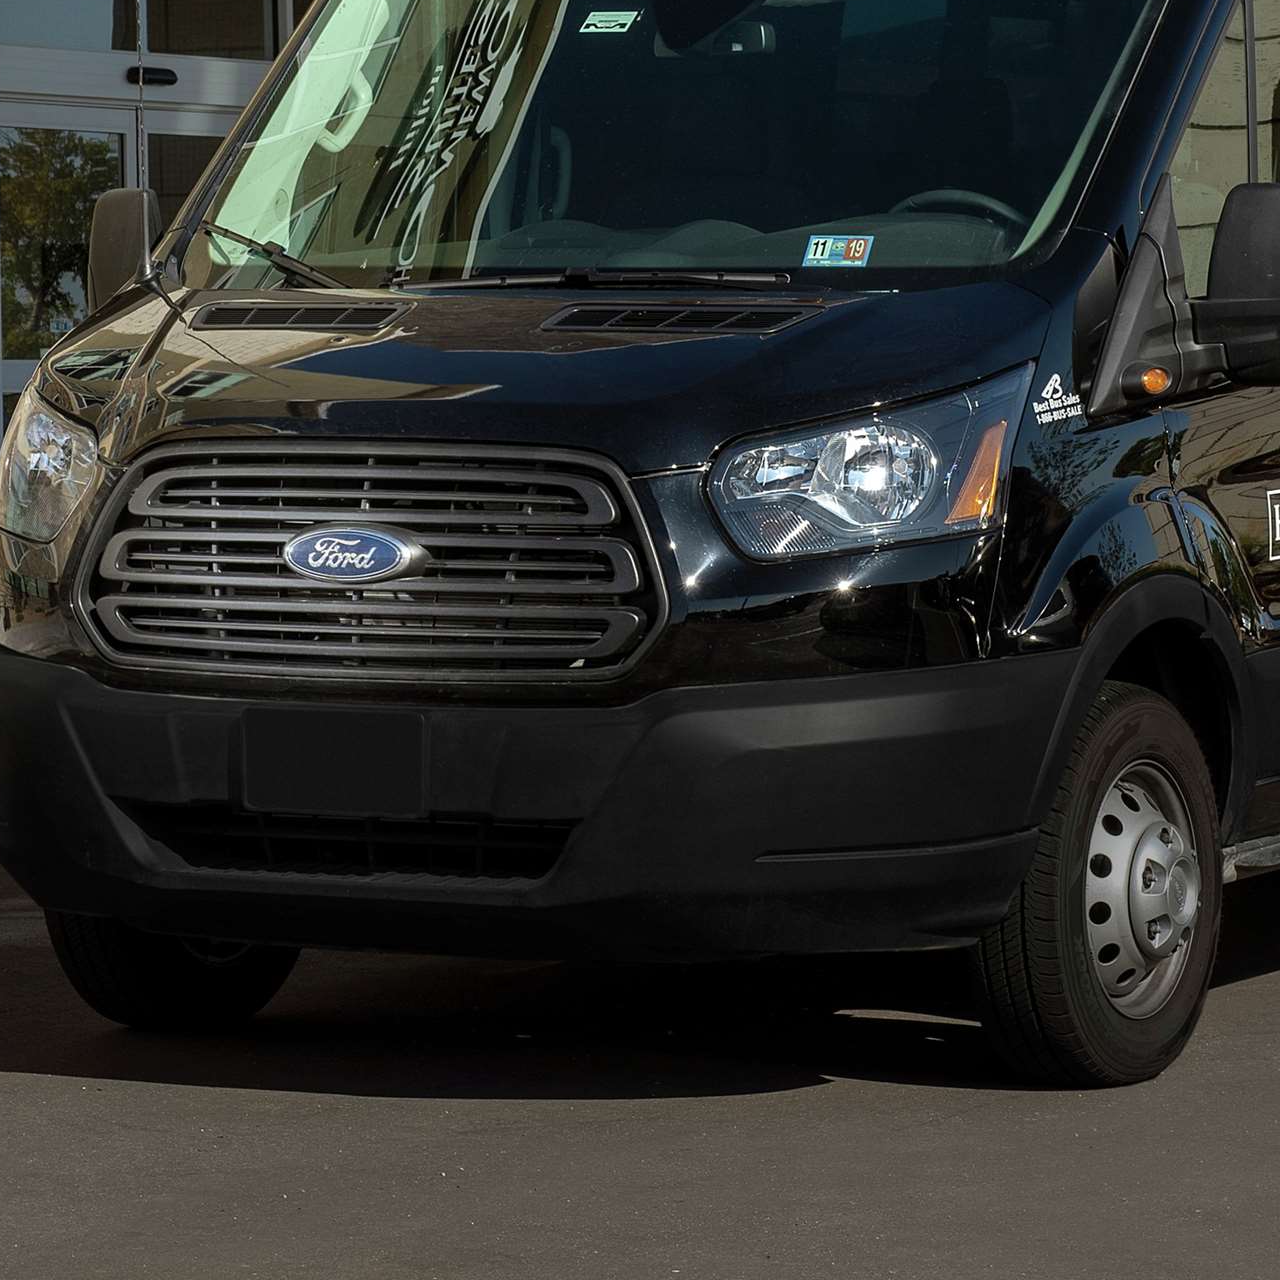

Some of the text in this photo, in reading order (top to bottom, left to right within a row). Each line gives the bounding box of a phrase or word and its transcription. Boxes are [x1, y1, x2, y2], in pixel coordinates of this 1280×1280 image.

[813, 239, 828, 257] 11
[848, 239, 865, 257] 19
[308, 537, 377, 568] Ford
